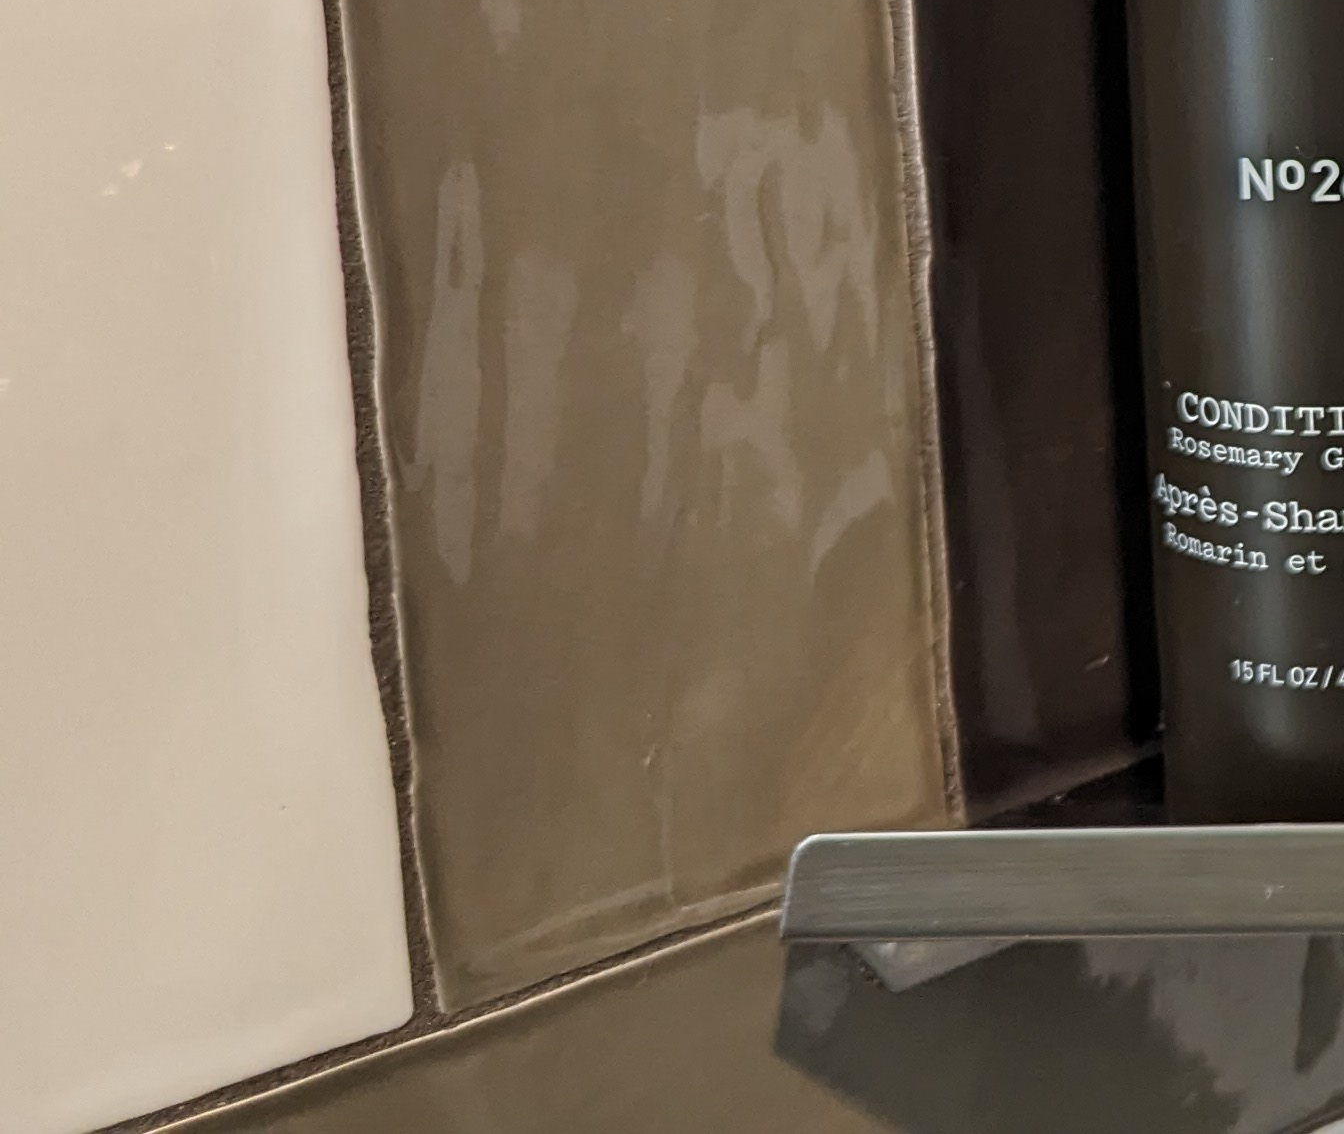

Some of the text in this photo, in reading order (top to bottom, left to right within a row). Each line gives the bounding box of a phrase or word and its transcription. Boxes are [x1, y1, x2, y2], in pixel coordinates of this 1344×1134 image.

[1169, 425, 1304, 476] Rosemary
[1160, 521, 1271, 572] Romarin
[1286, 552, 1328, 575] et
[1229, 657, 1255, 683] 15
[1256, 662, 1285, 687] FL
